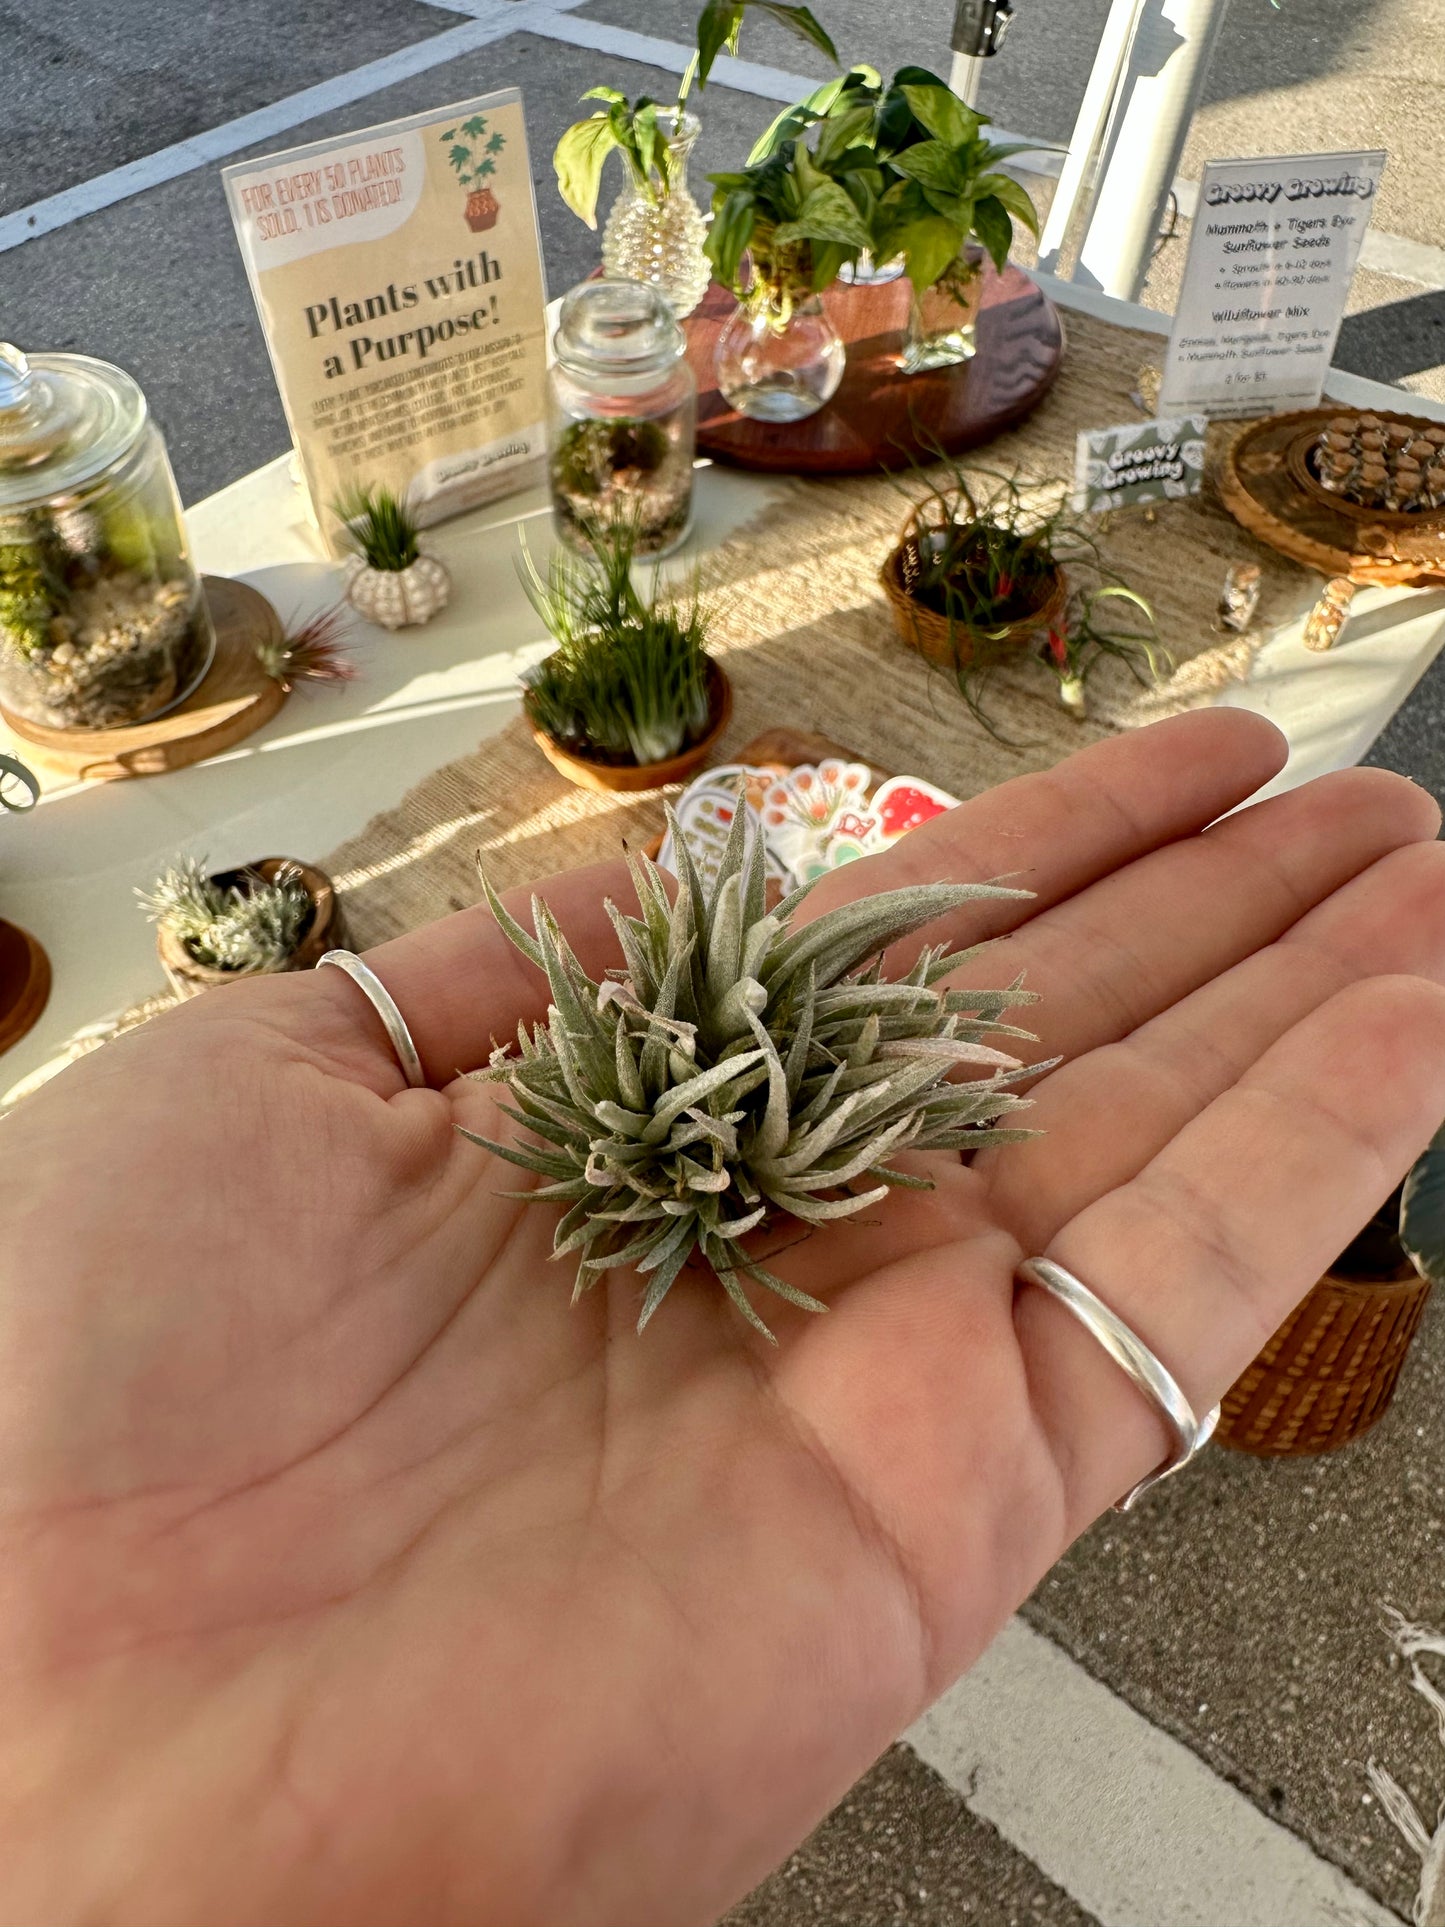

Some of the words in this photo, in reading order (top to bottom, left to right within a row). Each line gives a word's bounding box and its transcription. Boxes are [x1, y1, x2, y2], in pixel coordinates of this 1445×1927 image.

[241, 183, 275, 214] FOR
[276, 170, 321, 205] EVERY
[324, 163, 346, 191] 50
[347, 148, 406, 182] PLANTS
[315, 198, 333, 225] IS
[332, 178, 402, 219] DONATED!
[1205, 182, 1282, 206] Groovy
[1283, 172, 1373, 200] Growing
[304, 283, 419, 338] Plants
[424, 251, 502, 299] with
[323, 354, 345, 379] a
[349, 295, 499, 370] Purpose!
[1101, 460, 1184, 490] Growing
[1108, 442, 1181, 472] Groovy
